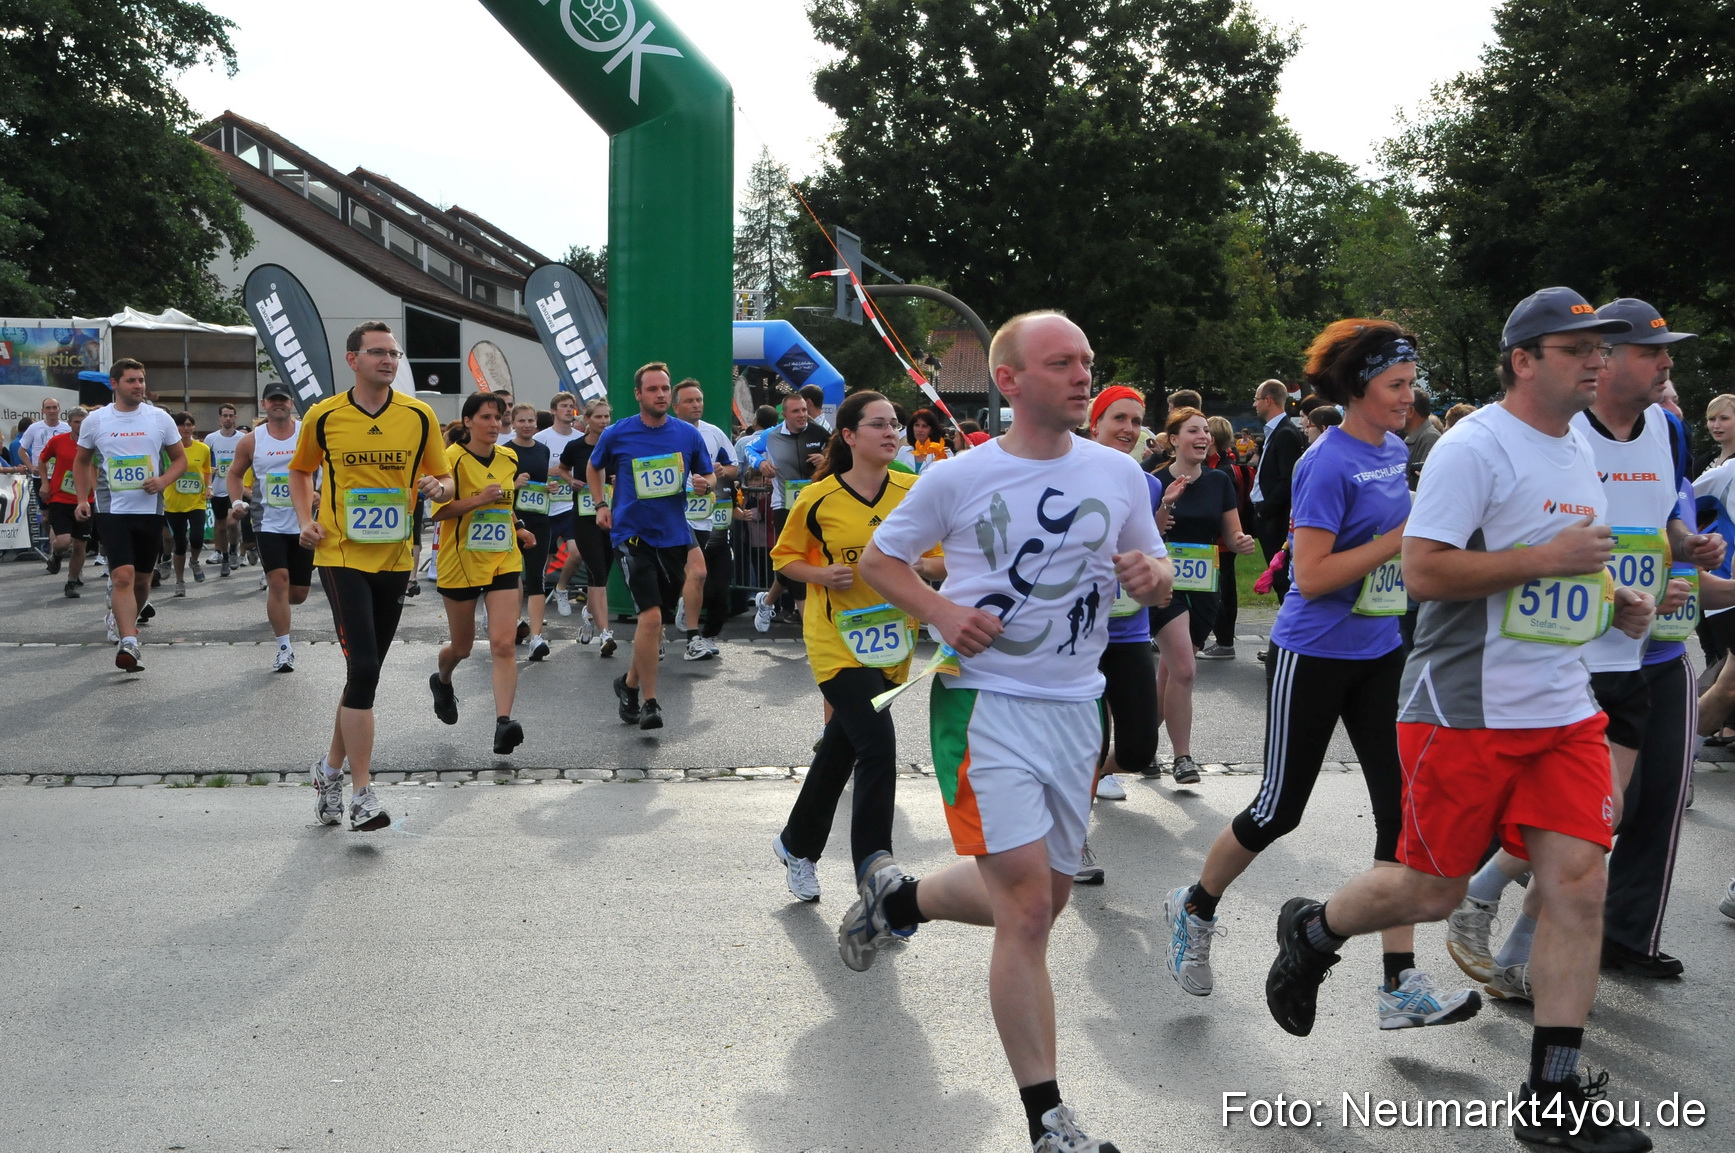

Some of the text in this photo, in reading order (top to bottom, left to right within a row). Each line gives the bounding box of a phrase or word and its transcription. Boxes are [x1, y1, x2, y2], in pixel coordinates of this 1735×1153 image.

[19, 351, 85, 370] Logistics
[346, 452, 402, 464] ONLINE
[114, 467, 145, 482] 486
[641, 468, 675, 488] 130
[1612, 472, 1660, 482] KLEBL
[177, 480, 200, 489] 1279
[271, 484, 290, 498] 49
[521, 491, 544, 506] 546
[684, 499, 707, 512] 22
[1560, 503, 1597, 517] KLEBL
[352, 507, 399, 529] 220
[471, 523, 506, 541] 226
[1519, 579, 1589, 622] 510
[1530, 618, 1557, 629] Stefan
[849, 623, 900, 654] 225
